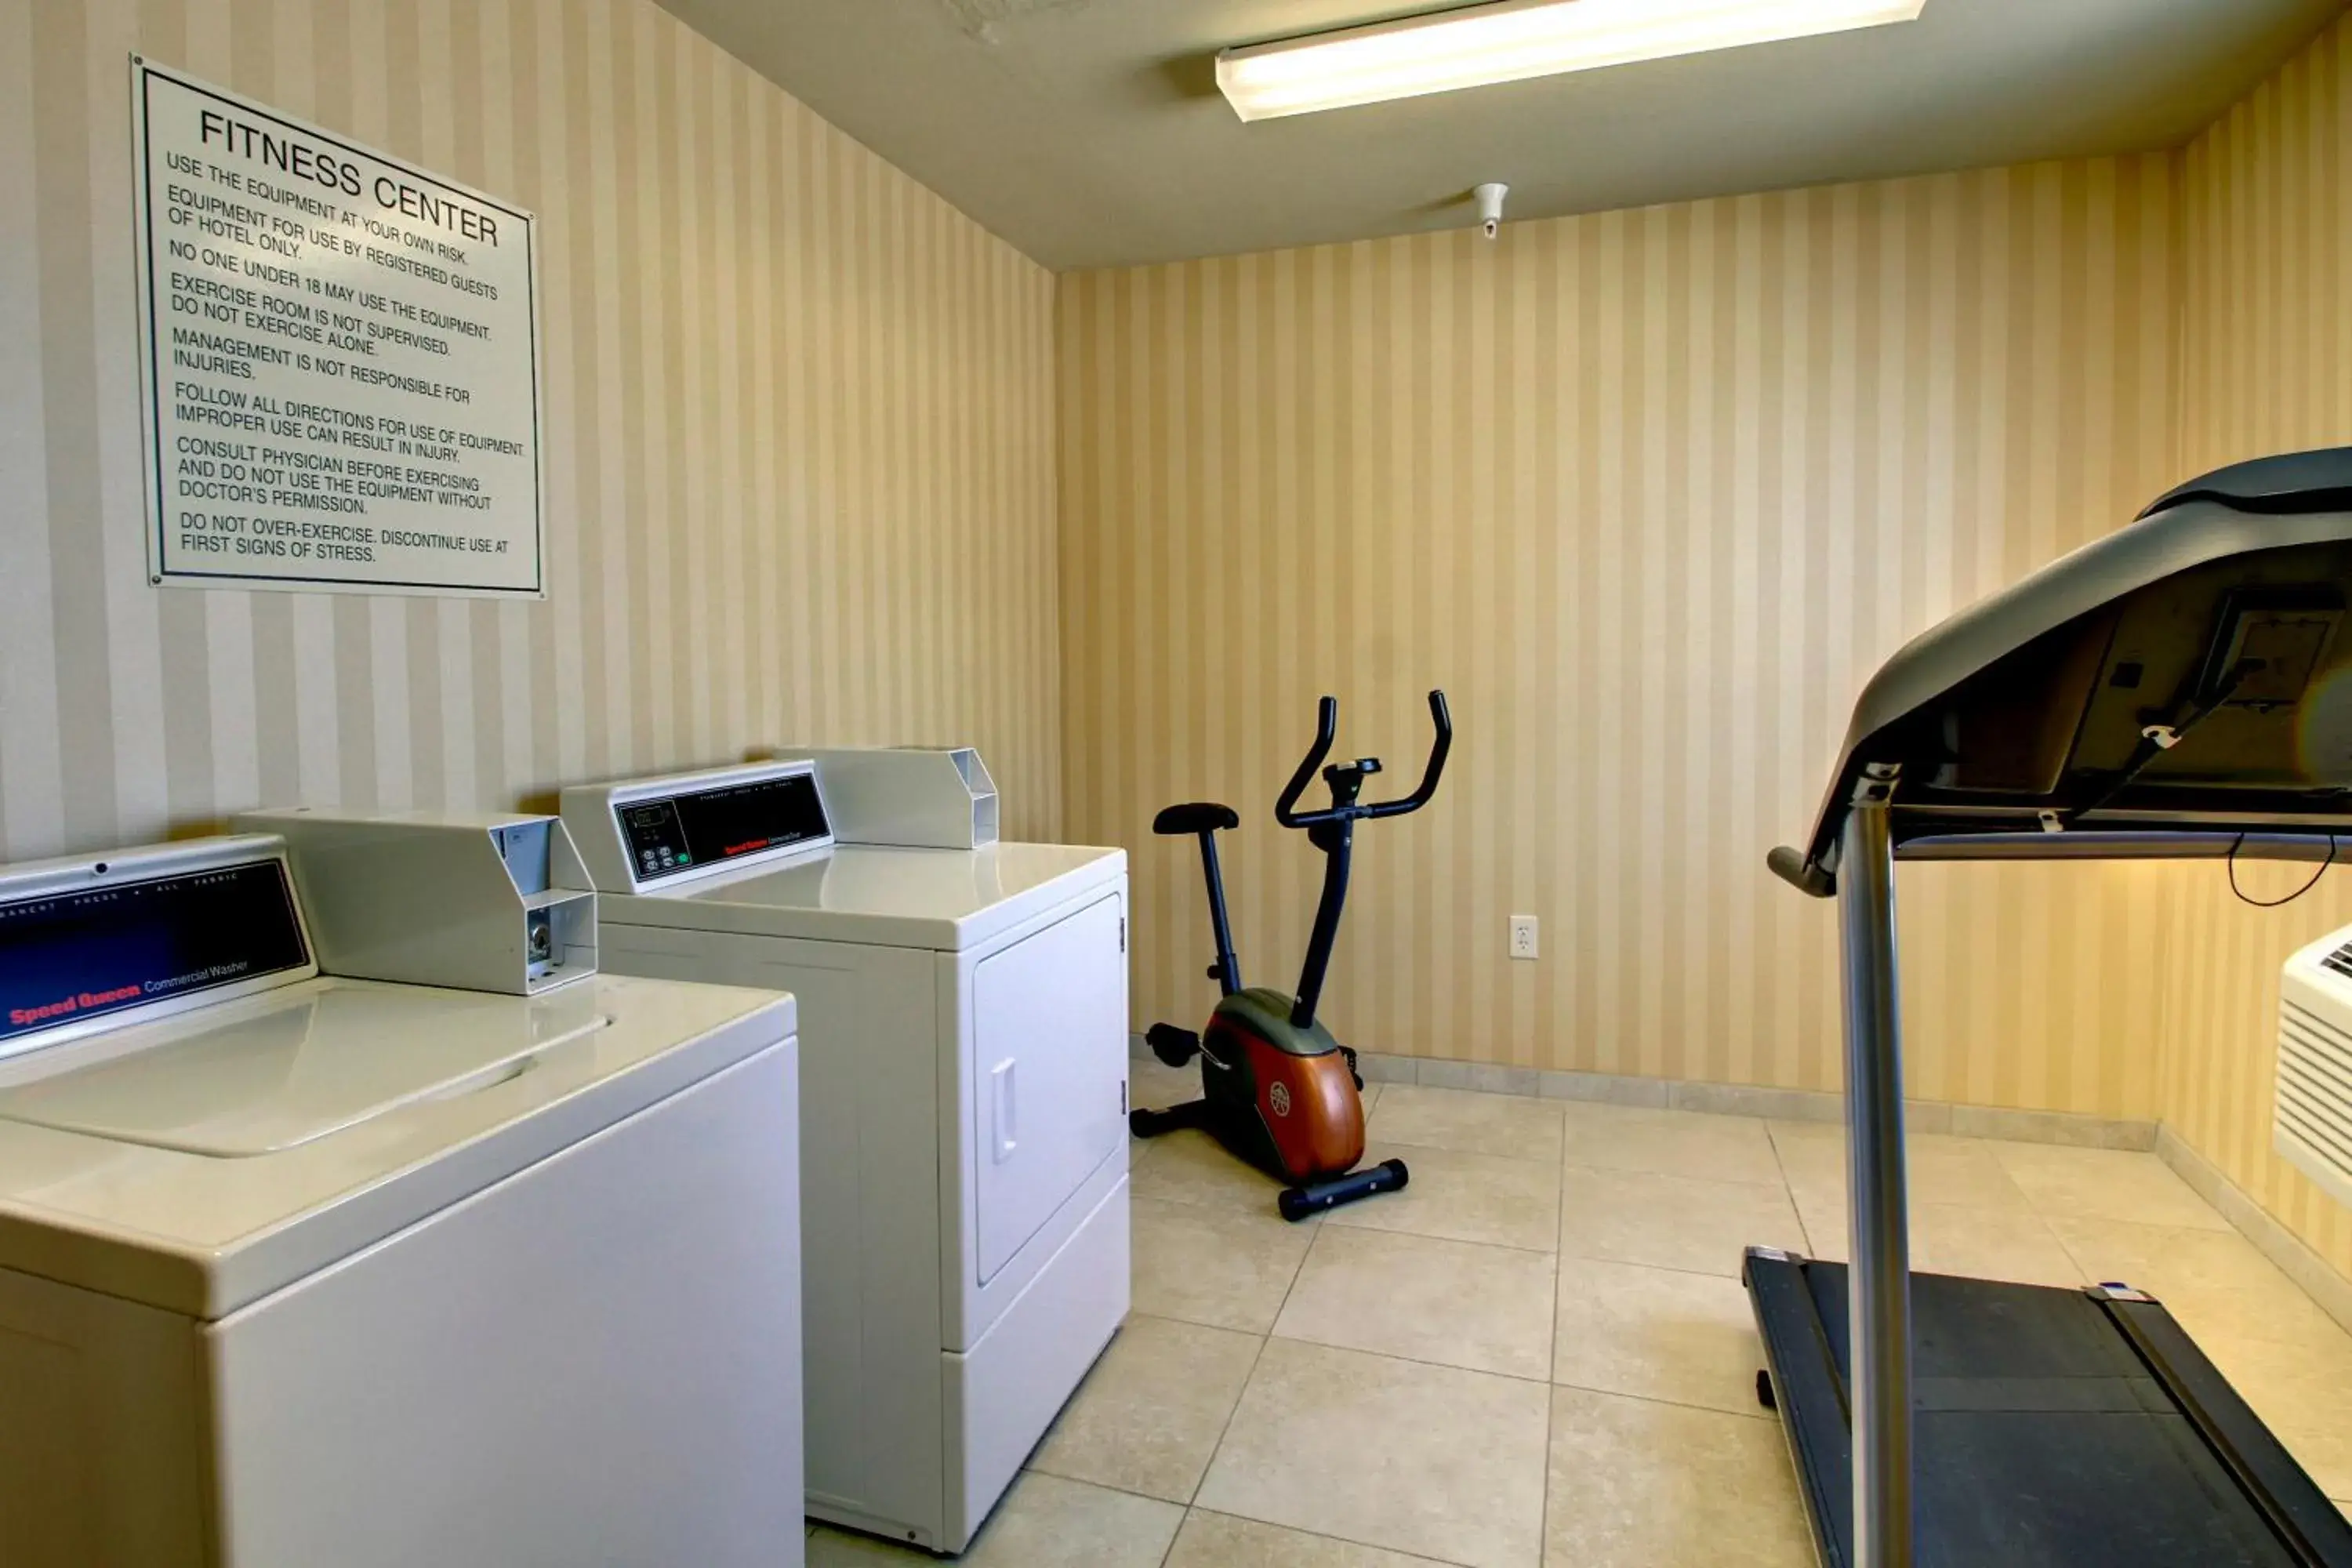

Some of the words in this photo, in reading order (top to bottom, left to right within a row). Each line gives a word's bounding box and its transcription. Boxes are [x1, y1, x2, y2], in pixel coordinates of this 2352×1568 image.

[166, 150, 202, 178] USE
[206, 164, 241, 191] THE
[246, 177, 336, 220] EQUIPMENT
[341, 210, 358, 227] AT
[361, 216, 400, 242] YOUR
[403, 231, 434, 254] OWN
[437, 242, 467, 266] RISK.
[200, 109, 361, 196] FITNESS
[374, 176, 497, 247] CENTER
[168, 206, 194, 226] OF
[198, 215, 254, 246] HOTEL
[259, 233, 300, 258] ONLY.
[168, 183, 267, 227] EQUIPMENT
[272, 216, 304, 241] FOR
[309, 228, 339, 251] USE
[343, 239, 361, 256] BY
[366, 246, 448, 284] REGISTERED
[451, 274, 497, 300] GUESTS
[169, 238, 196, 260] NO
[201, 248, 238, 273] ONE
[244, 259, 299, 289] UNDER
[305, 278, 321, 294] 18
[325, 281, 354, 303] MAY
[358, 292, 387, 312] USE
[390, 300, 417, 321] THE
[171, 271, 257, 307] EXERCISE
[262, 294, 310, 321] ROOM
[314, 308, 328, 325] IS
[332, 313, 364, 333] NOT
[366, 321, 450, 355] SUPERVISED.
[172, 293, 198, 314] DO
[203, 300, 240, 324] NOT
[245, 310, 323, 343] EXERCISE
[327, 332, 377, 357] ALONE.
[172, 326, 292, 365] MANAGEMENT
[296, 354, 310, 370] IS
[315, 357, 345, 376] NOT
[350, 365, 441, 397] RESPONSIBLE
[445, 386, 470, 405] FOR
[174, 348, 256, 379] INJURIES.
[175, 381, 246, 408] FOLLOW
[252, 395, 281, 415] ALL
[285, 401, 375, 430] DIRECTIONS
[378, 418, 406, 436] FOR
[409, 423, 436, 441] USE
[438, 429, 456, 444] OF
[176, 403, 265, 432] IMPROPER
[270, 418, 303, 438] USE
[307, 424, 337, 443] CAN
[342, 430, 394, 452] RESULT
[398, 440, 411, 455] IN
[415, 443, 460, 462] INJURY.
[176, 436, 257, 461] CONSULT
[262, 448, 343, 473] PHYSICIAN
[347, 459, 402, 481] BEFORE
[405, 468, 479, 492] EXERCISING
[178, 458, 215, 477] AND
[220, 463, 245, 481] DO
[250, 466, 285, 485] NOT
[289, 471, 320, 489] USE
[323, 476, 354, 494] THE
[358, 480, 434, 502] EQUIPMENT
[437, 491, 491, 510] WITHOUT
[179, 479, 267, 504] DOCTOR'S
[271, 489, 367, 514] PERMISSION.
[180, 511, 206, 530] DO
[212, 514, 247, 532] NOT
[252, 517, 376, 543] OVER-EXERCISE.
[381, 529, 465, 550] DISCONTINUE
[469, 539, 492, 552] USE
[495, 540, 507, 552] AT
[181, 533, 230, 552] FIRST
[235, 536, 285, 556] SIGNS
[290, 541, 311, 557] OF
[316, 543, 376, 561] STRESS.
[9, 996, 78, 1025] Speed
[78, 985, 140, 1007] Queen
[144, 969, 209, 993] Commercial
[210, 960, 248, 977] Washer
